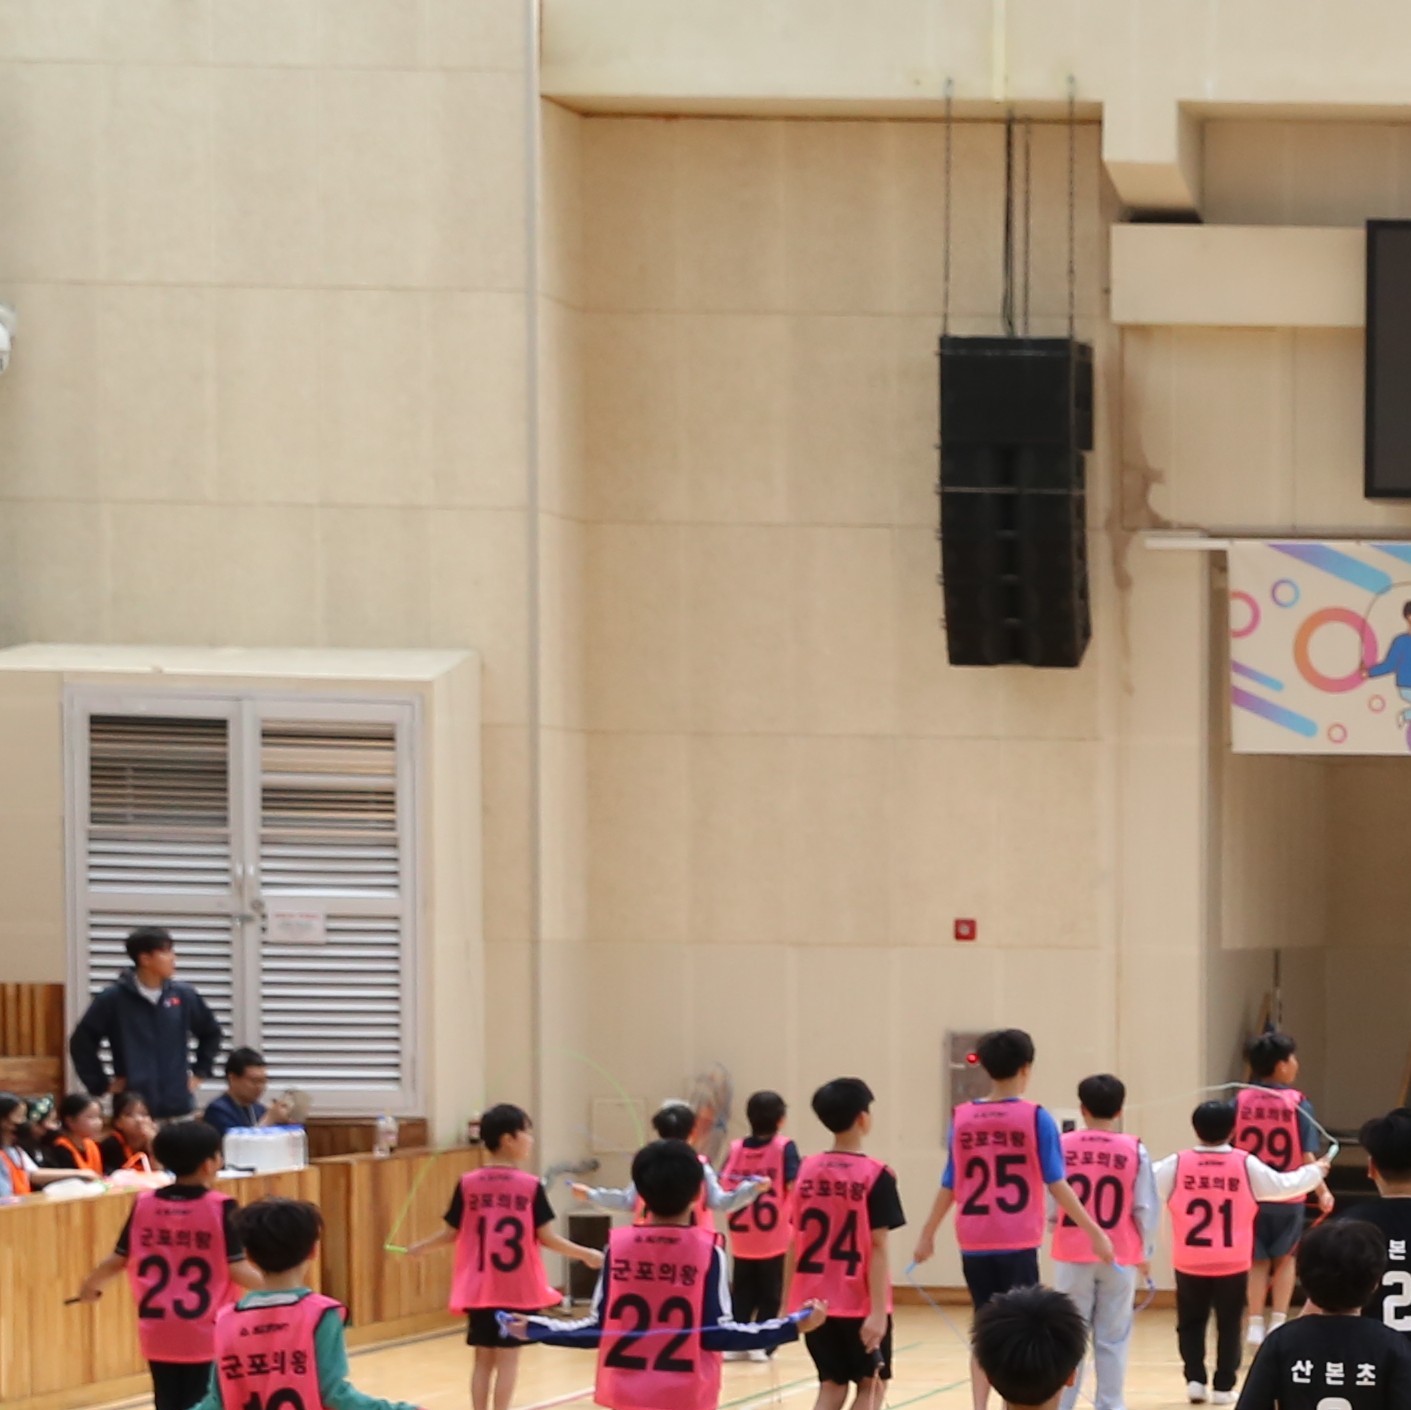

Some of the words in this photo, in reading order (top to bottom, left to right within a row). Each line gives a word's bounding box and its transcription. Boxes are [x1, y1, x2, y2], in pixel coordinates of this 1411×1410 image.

[800, 1180, 867, 1203] 군포의왕
[961, 1154, 1030, 1216] 25
[1062, 1174, 1125, 1231] 20
[476, 1217, 523, 1273] 13
[796, 1207, 862, 1277] 24
[1185, 1198, 1233, 1249] 21
[137, 1254, 213, 1320] 23
[611, 1258, 698, 1287] 군포의왕
[604, 1293, 695, 1374] 22
[221, 1349, 308, 1381] 군포의왕
